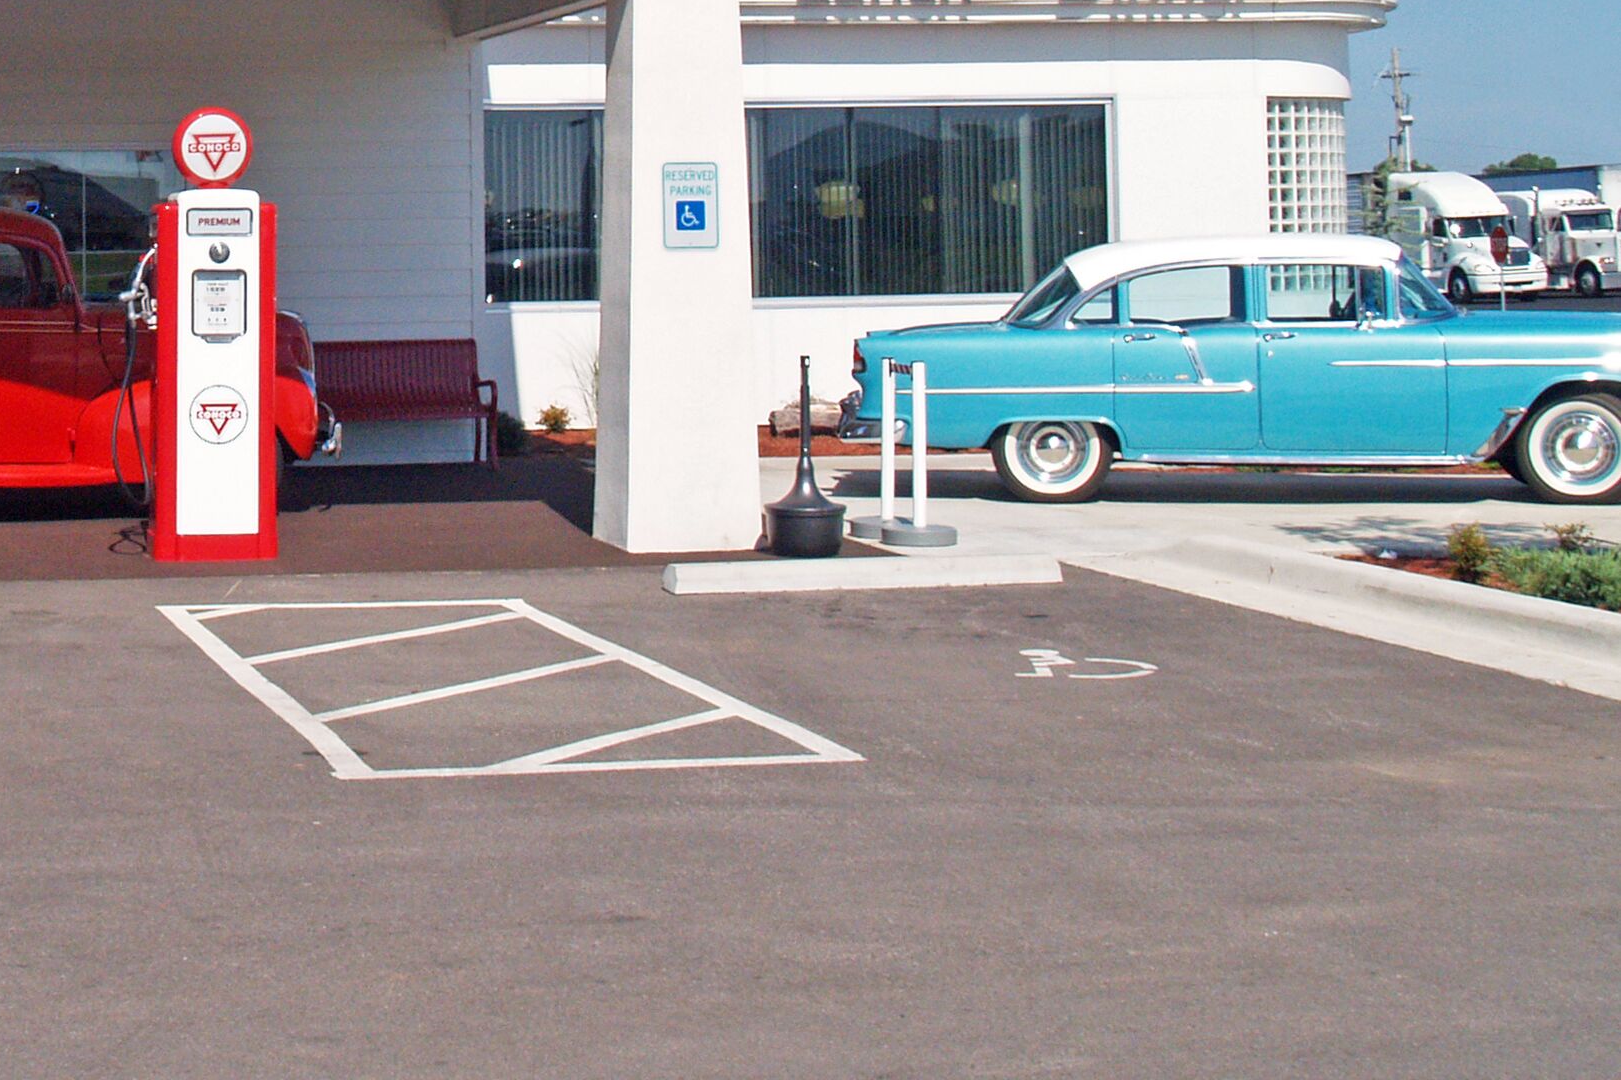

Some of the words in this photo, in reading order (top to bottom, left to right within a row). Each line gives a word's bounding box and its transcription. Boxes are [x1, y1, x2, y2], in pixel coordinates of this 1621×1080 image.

[188, 142, 241, 153] CONOCO
[665, 170, 716, 181] RESERVED
[669, 185, 712, 196] PARKING
[197, 217, 241, 226] PREMIUM
[196, 410, 242, 420] CONOCO
